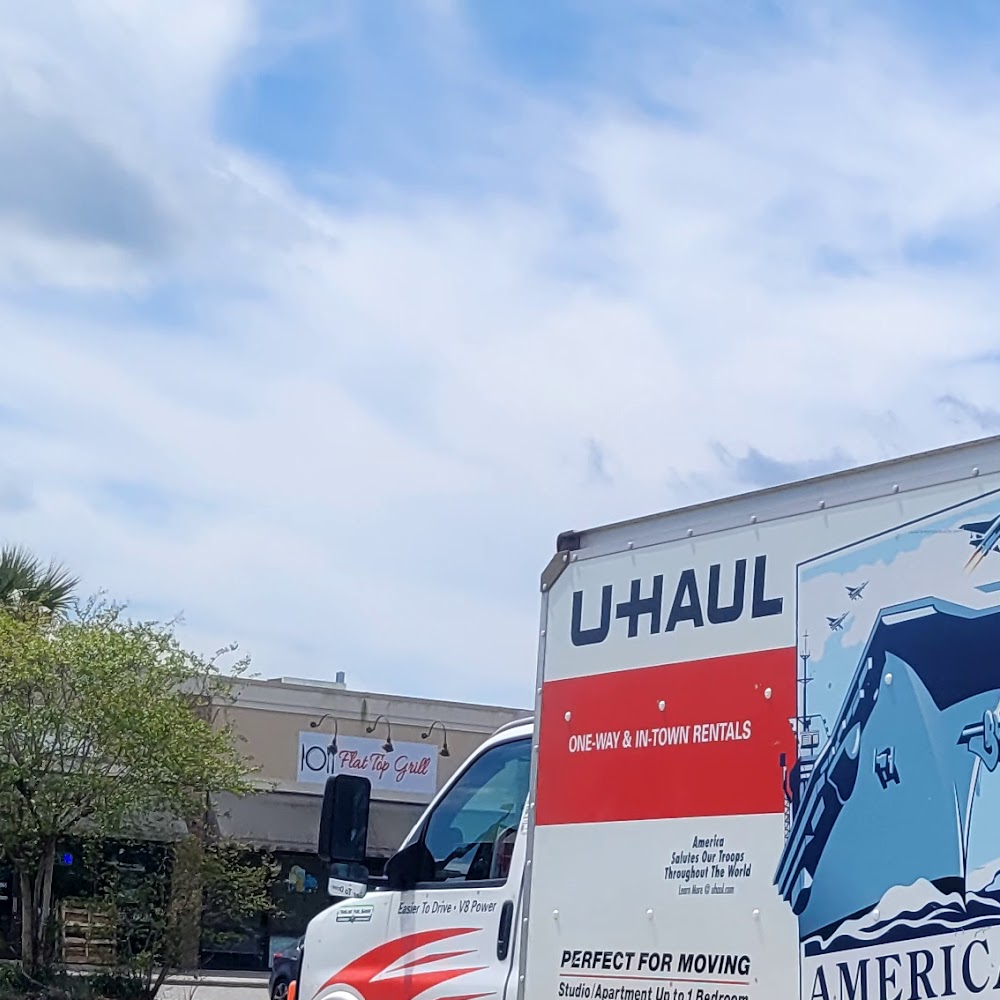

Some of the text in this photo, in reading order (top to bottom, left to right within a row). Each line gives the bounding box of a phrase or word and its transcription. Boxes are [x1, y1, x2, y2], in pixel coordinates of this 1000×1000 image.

[571, 555, 784, 647] U-HAUL
[568, 720, 752, 753] ONE-WAY & IN-TOWN RENTALS
[339, 750, 431, 782] Flat Top Grill
[692, 834, 724, 849] America
[671, 850, 745, 866] Salutes Our Troops
[664, 863, 752, 882] Throughout The World
[397, 900, 498, 915] Easier To Drive V8 Power
[560, 950, 751, 976] PERFECT FOR MOVING
